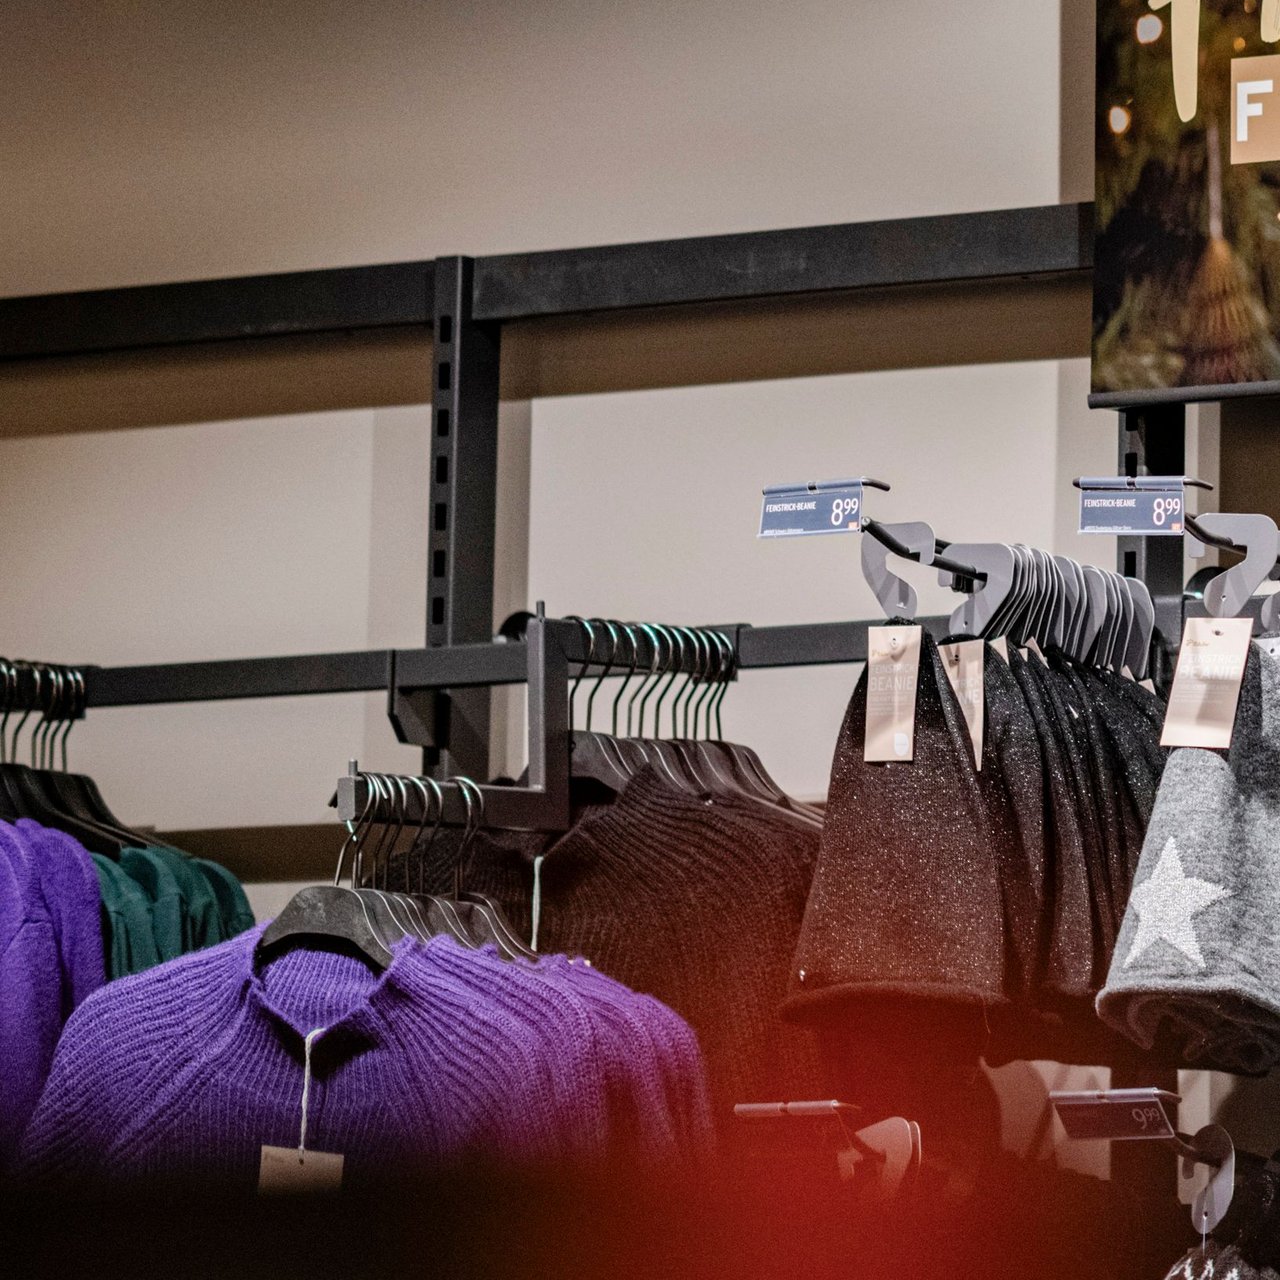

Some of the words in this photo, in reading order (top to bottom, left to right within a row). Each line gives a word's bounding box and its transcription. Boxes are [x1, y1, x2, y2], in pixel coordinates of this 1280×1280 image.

[765, 501, 817, 513] FEINSTRICK-BEANIE
[1084, 498, 1137, 508] FEINSTRICK-BEANIE
[870, 675, 915, 691] BEANIE
